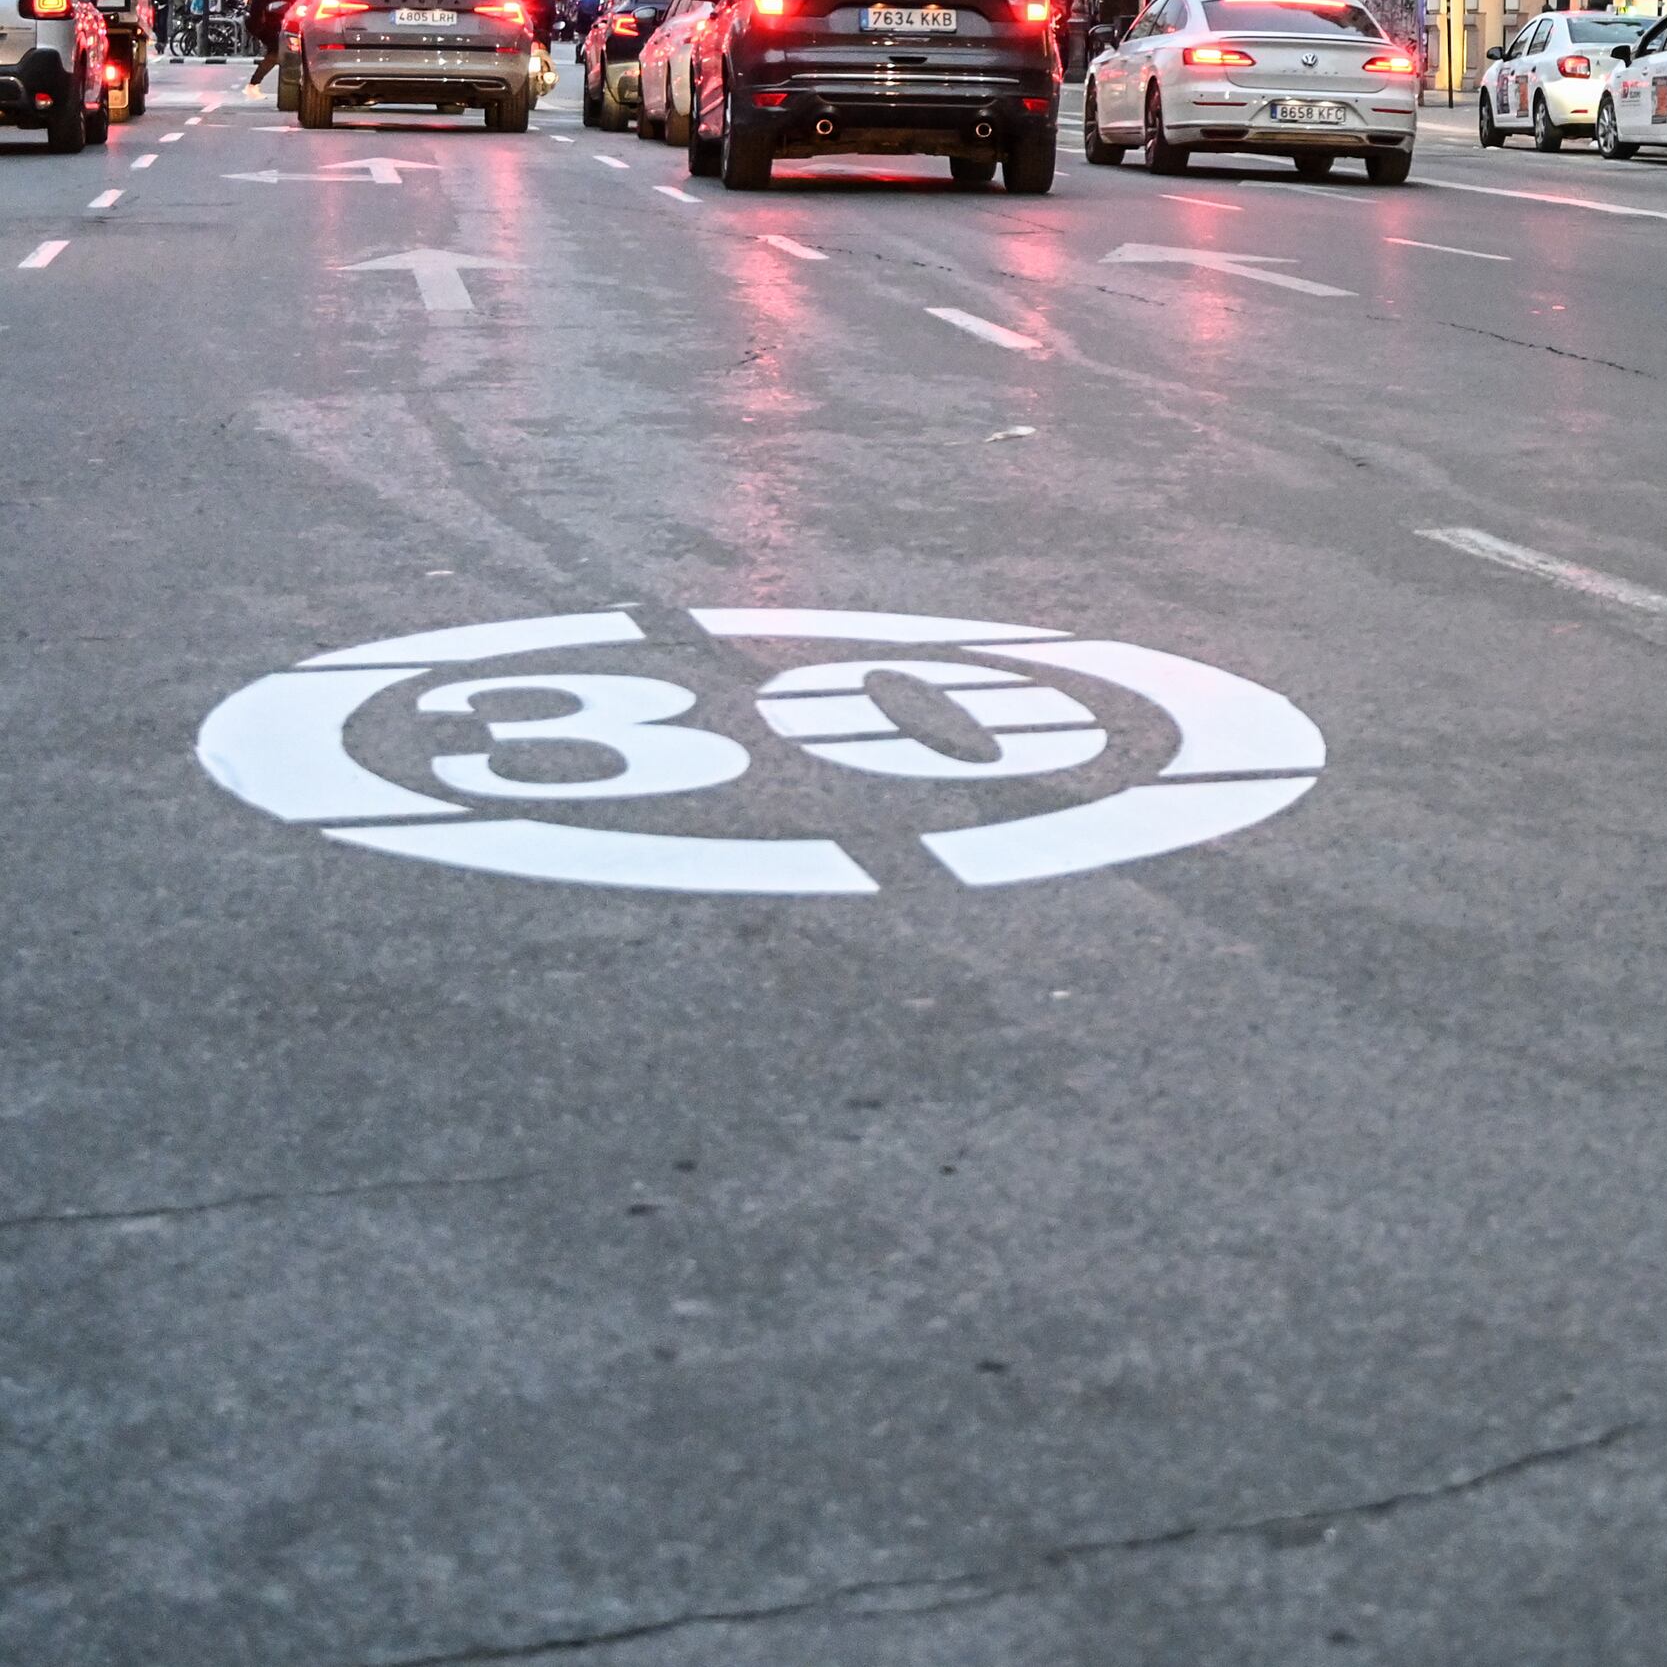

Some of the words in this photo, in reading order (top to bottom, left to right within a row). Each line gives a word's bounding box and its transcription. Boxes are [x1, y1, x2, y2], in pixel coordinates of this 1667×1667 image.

[399, 12, 428, 22] 4805
[432, 12, 454, 23] LRH
[872, 11, 914, 25] 7634
[921, 12, 952, 26] KKB
[1280, 107, 1314, 119] 8658
[1318, 108, 1344, 120] KFC
[416, 659, 1107, 801] 30
